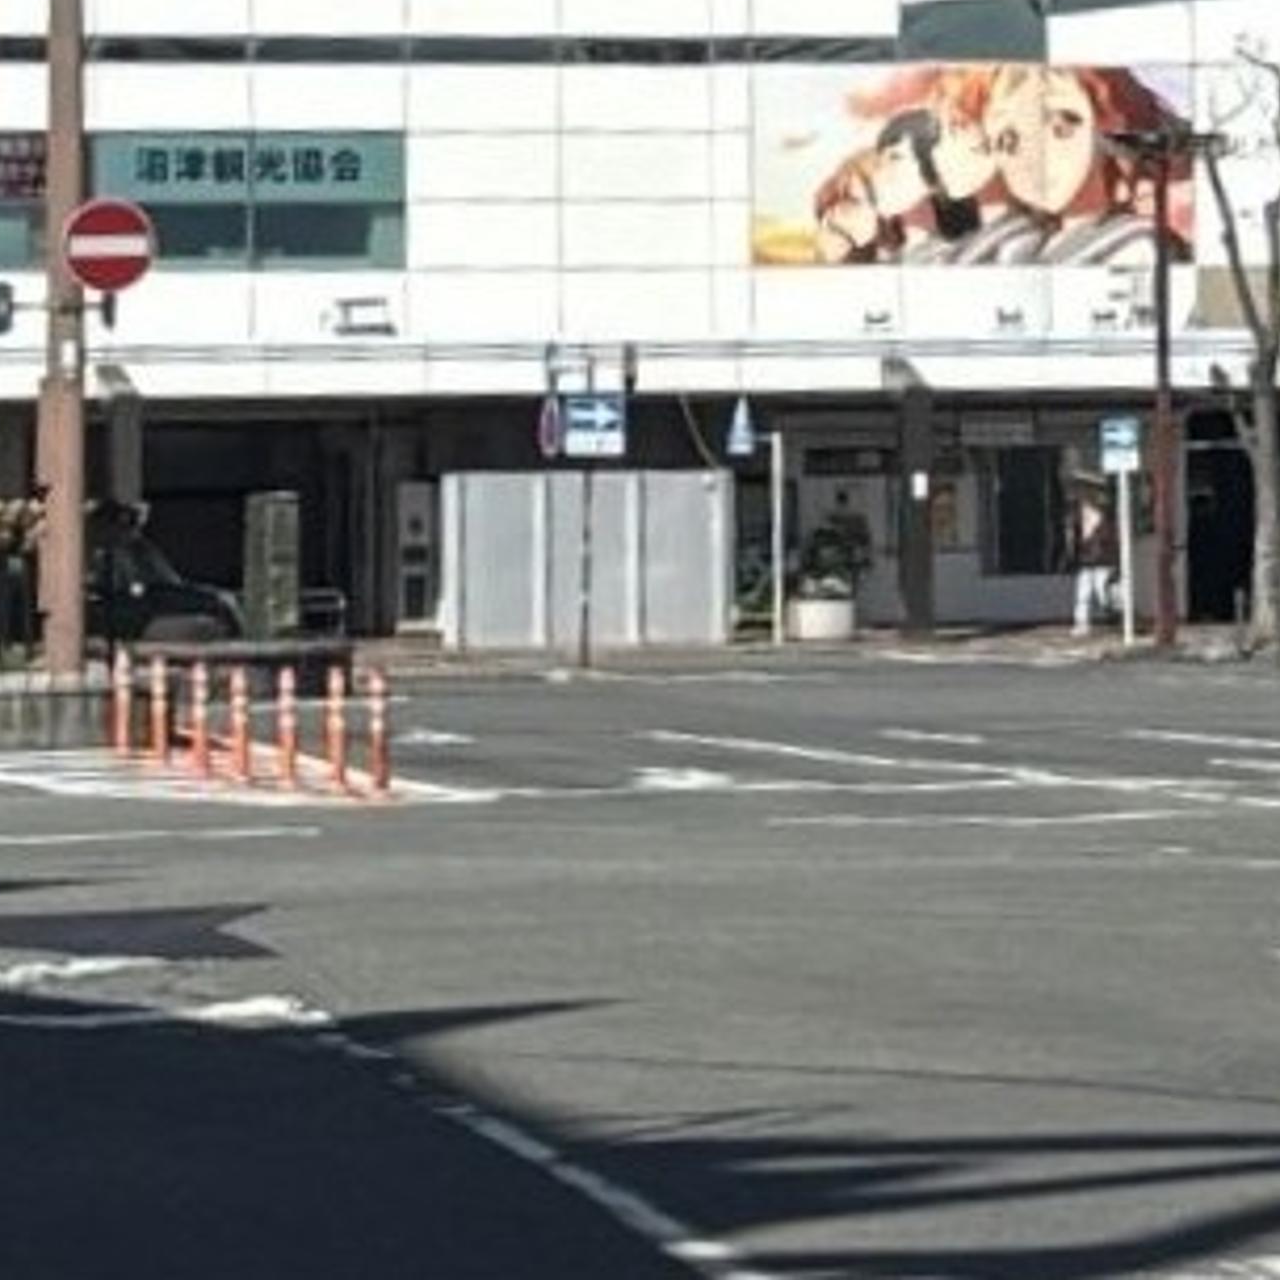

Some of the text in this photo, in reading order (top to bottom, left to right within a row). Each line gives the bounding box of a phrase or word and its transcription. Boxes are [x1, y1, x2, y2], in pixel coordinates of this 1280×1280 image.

[134, 145, 362, 183] 沼津観光協会
